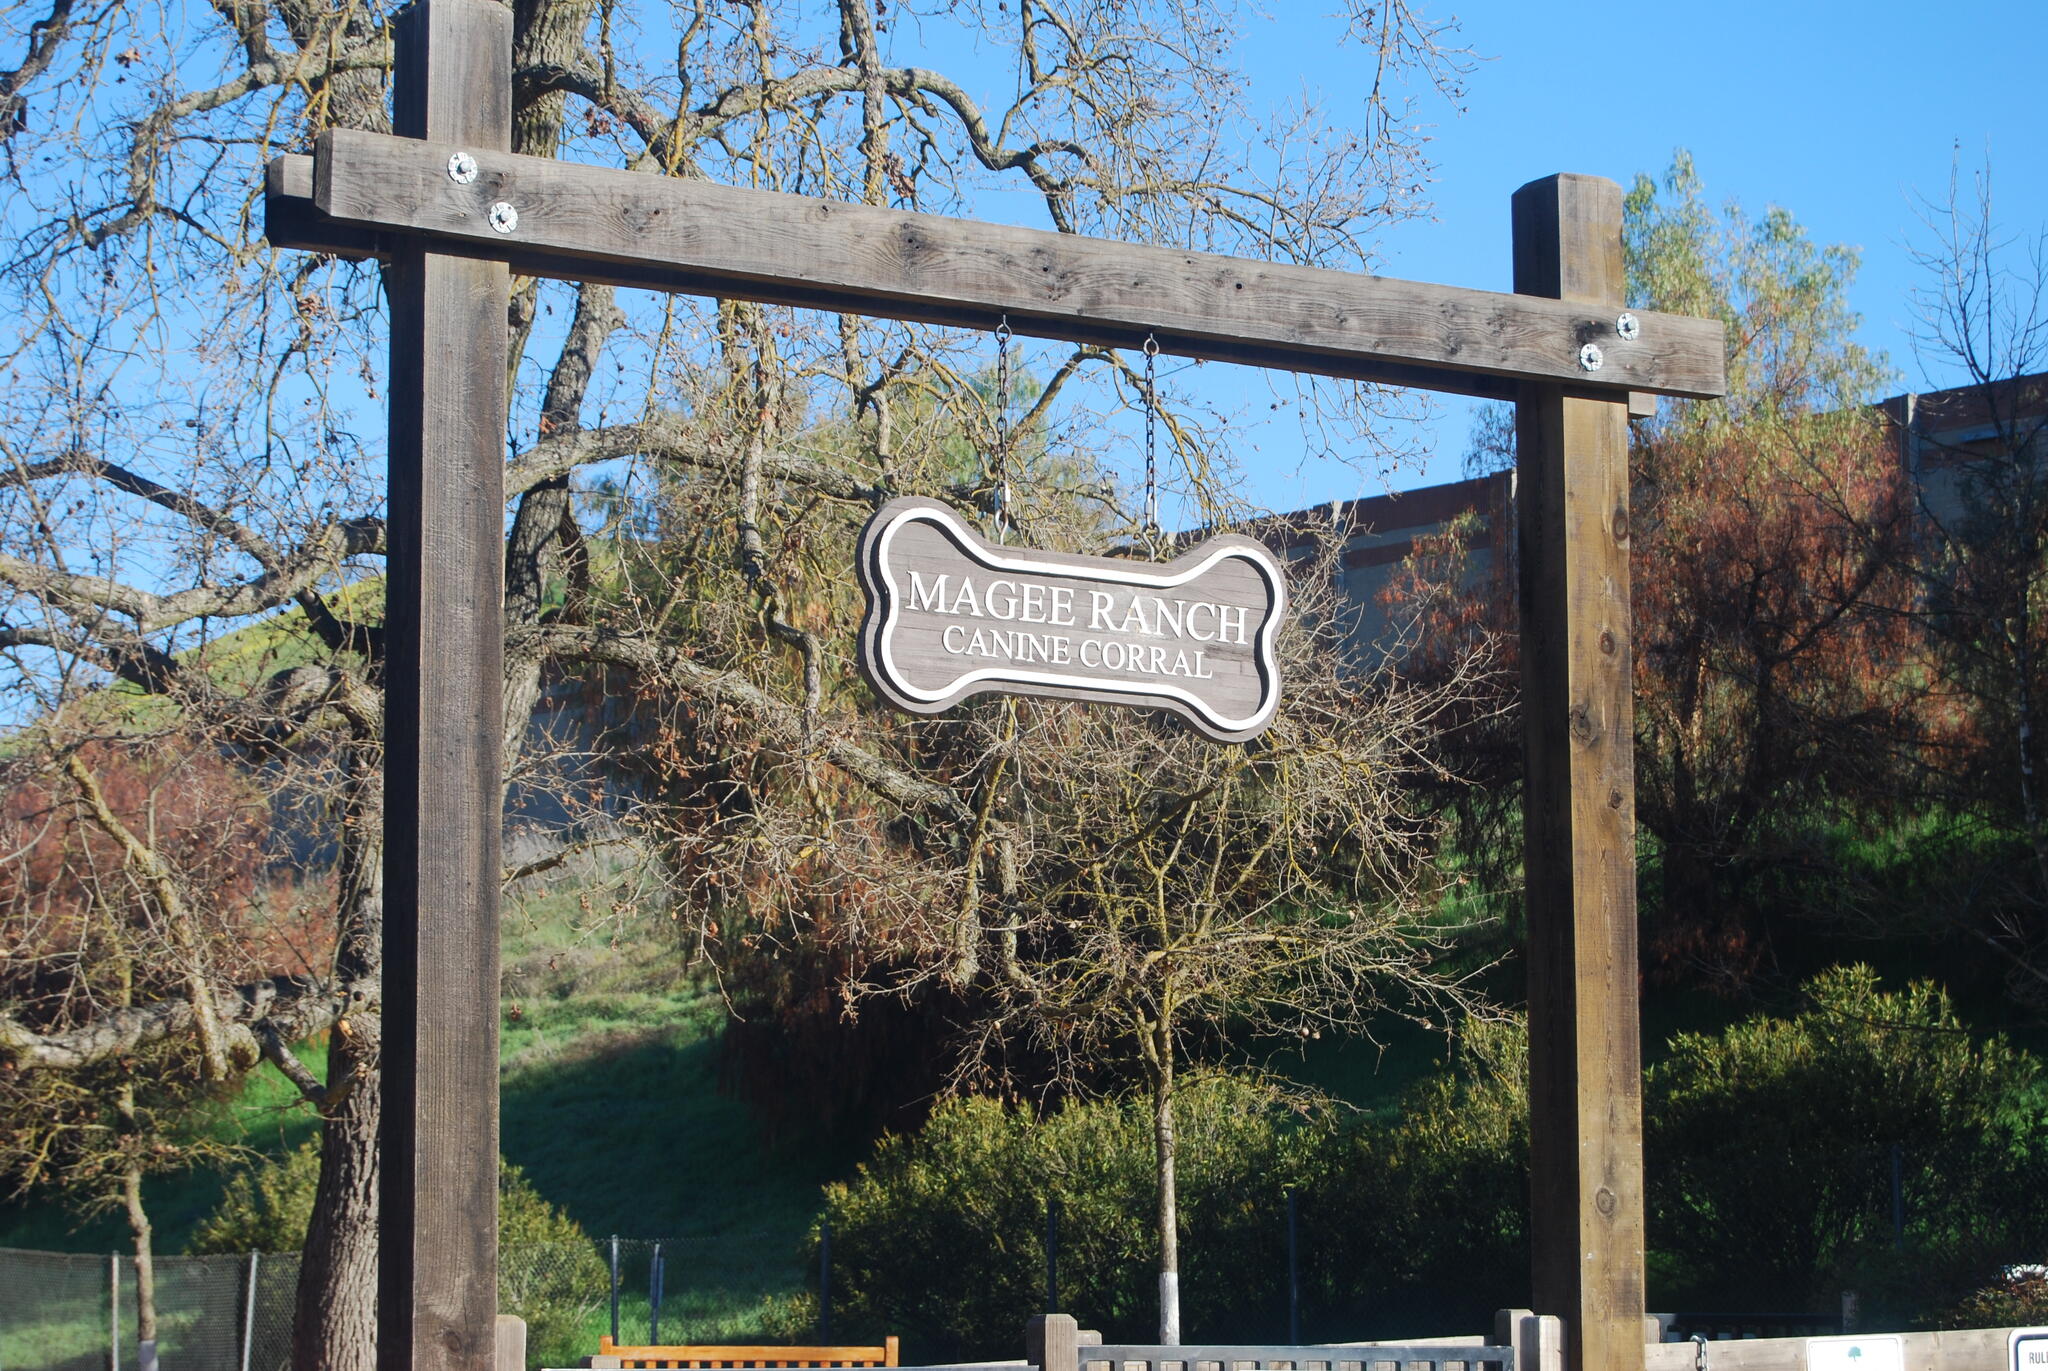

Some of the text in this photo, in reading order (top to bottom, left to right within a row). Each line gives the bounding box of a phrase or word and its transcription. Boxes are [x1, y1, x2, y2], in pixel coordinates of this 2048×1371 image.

[906, 570, 1249, 645] MAGEE RANCH
[942, 625, 1213, 679] CANINE CORRAL
